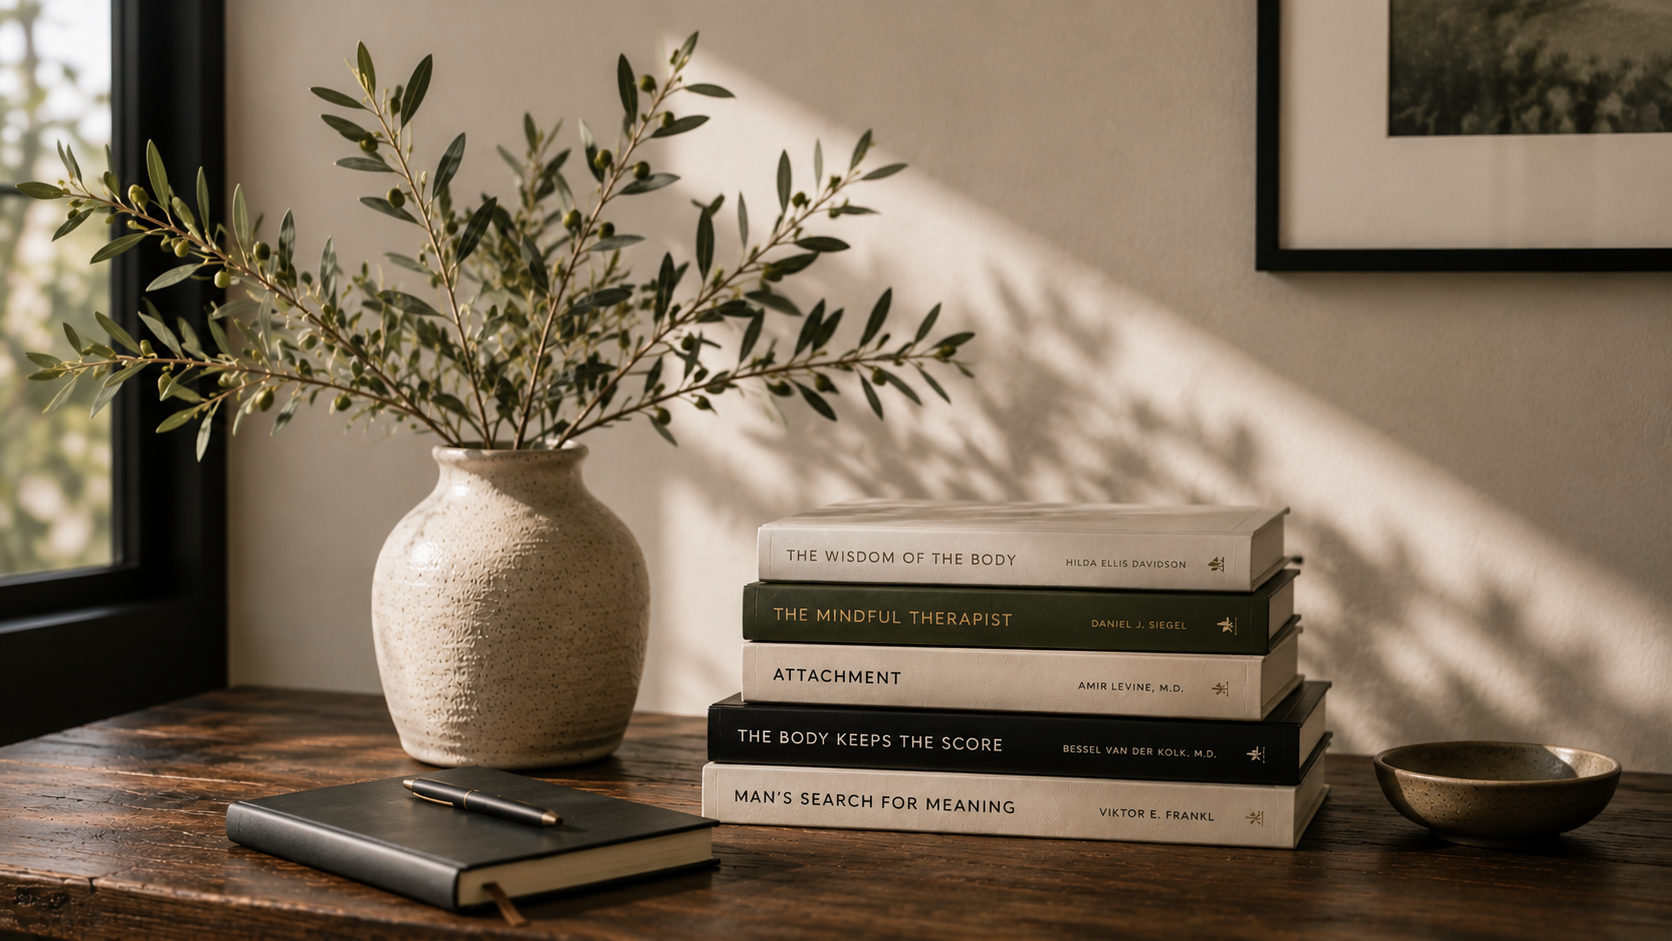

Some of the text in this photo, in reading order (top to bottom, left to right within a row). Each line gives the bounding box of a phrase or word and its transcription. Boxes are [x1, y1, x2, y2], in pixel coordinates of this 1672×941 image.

[786, 549, 1017, 567] THE WISDOM OF THE BODY
[1065, 558, 1187, 569] HILDA ELLIS DAVIDSON
[773, 607, 1013, 627] THE MINDFUL THERAPIST
[1091, 619, 1187, 630] DANIEL J. SIEGEL
[773, 667, 902, 685] ATTACHMENT
[1077, 681, 1184, 694] AMIR LEVINE, M.D.
[737, 728, 1003, 752] THE BODY KEEPS THE SCORE
[1062, 744, 1102, 754] BESSEL
[1105, 746, 1128, 755] VAN
[1132, 746, 1153, 756] DER
[1194, 749, 1217, 759] M.D.
[734, 789, 1015, 814] MAN’S SEARCH FOR MEANING
[1099, 807, 1215, 822] VIKTOR E. FRANKL
